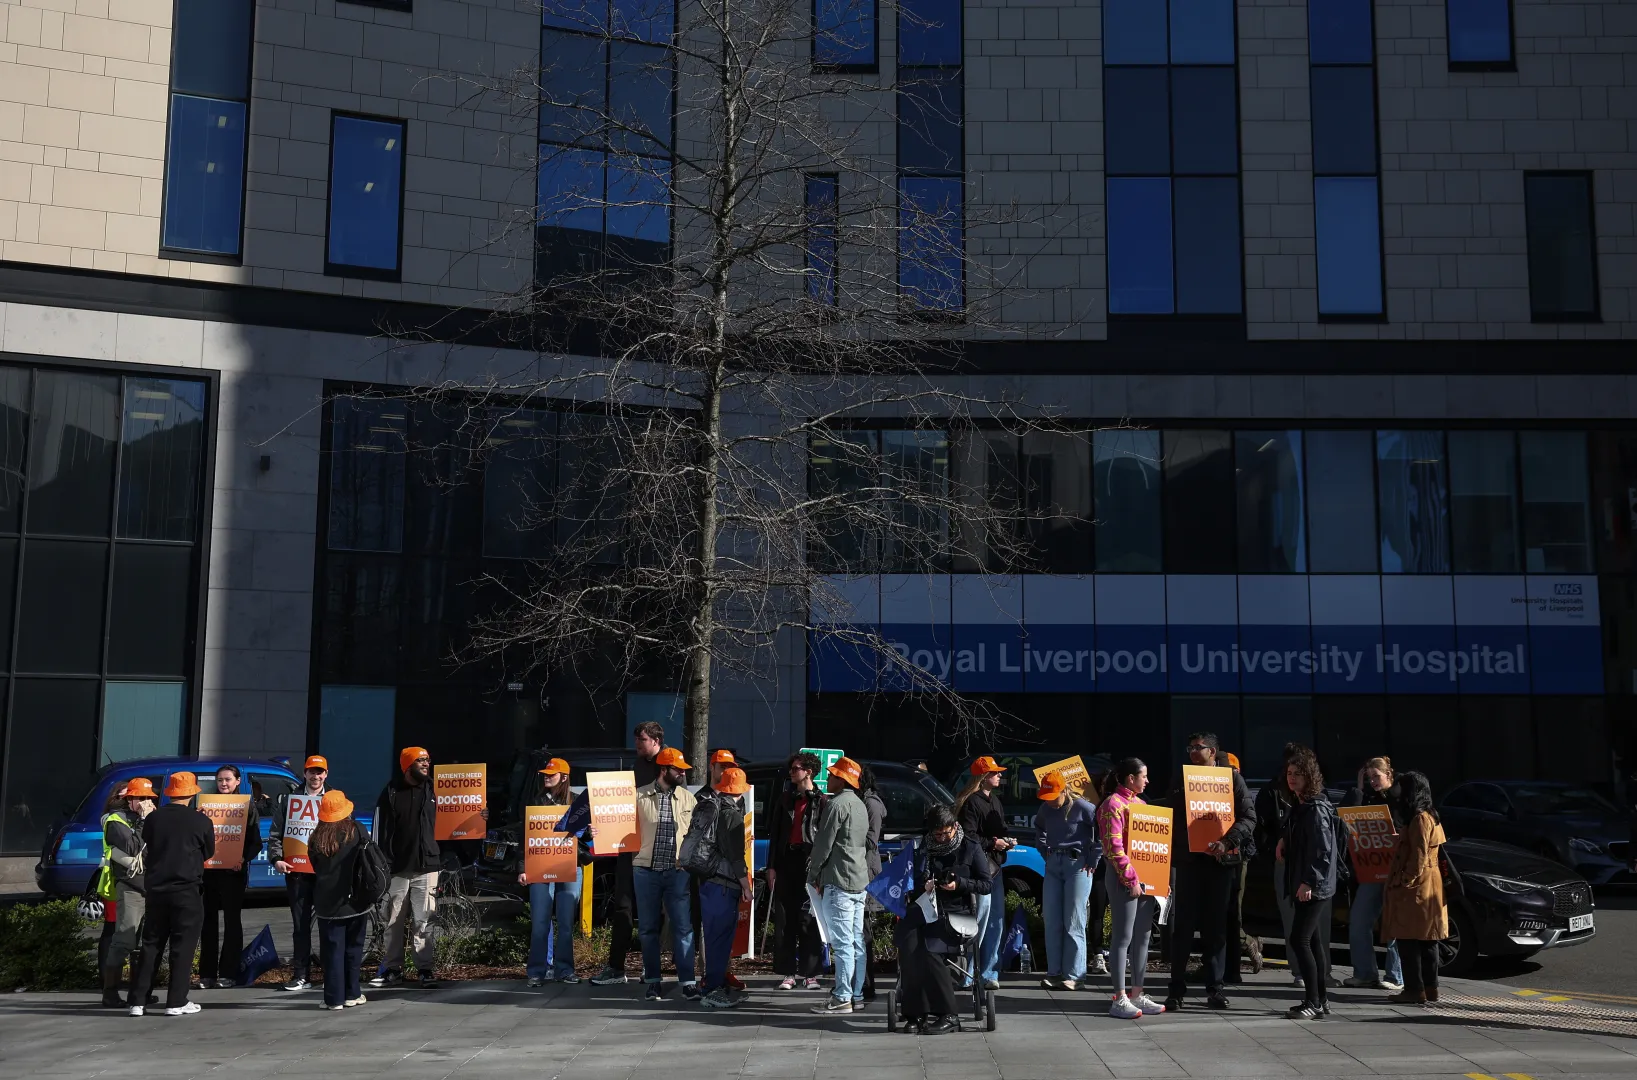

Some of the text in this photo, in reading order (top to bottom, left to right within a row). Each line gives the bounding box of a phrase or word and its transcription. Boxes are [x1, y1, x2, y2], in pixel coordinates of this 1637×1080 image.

[1555, 584, 1581, 594] NHS
[1511, 597, 1583, 605] University Hospitals
[1549, 605, 1583, 613] Liverpool
[886, 642, 1526, 682] Royal Liverpool University Hospital
[437, 778, 482, 789] DOCTORS
[1187, 774, 1214, 782] PATIENTS
[592, 786, 633, 797] DOCTORS
[1188, 782, 1230, 794] DOCTORS
[437, 794, 482, 805] DOCTORS
[437, 804, 482, 813] NEED JOBS
[593, 803, 635, 816] DOCTORS
[1189, 800, 1232, 813] DOCTORS
[595, 814, 636, 824] NEED JOBS
[1132, 812, 1170, 824] PATIENTS NEED
[1190, 812, 1232, 822] NEED JOBS
[1343, 811, 1386, 821] DOCTORS
[213, 824, 242, 834] CTORS
[286, 826, 315, 836] DOCTO
[529, 821, 558, 831] DOCT
[1132, 820, 1170, 836] DOCTORS
[1347, 819, 1389, 834] NEED
[220, 834, 241, 842] JOBS
[528, 837, 574, 847] DOCTORS
[1352, 833, 1395, 852] JOBS
[528, 847, 573, 856] NEED JOBS
[1131, 839, 1169, 855] DOCTORS
[1130, 851, 1168, 864] NEED JOBS
[1356, 851, 1394, 867] NOW
[244, 945, 269, 966] BMA
